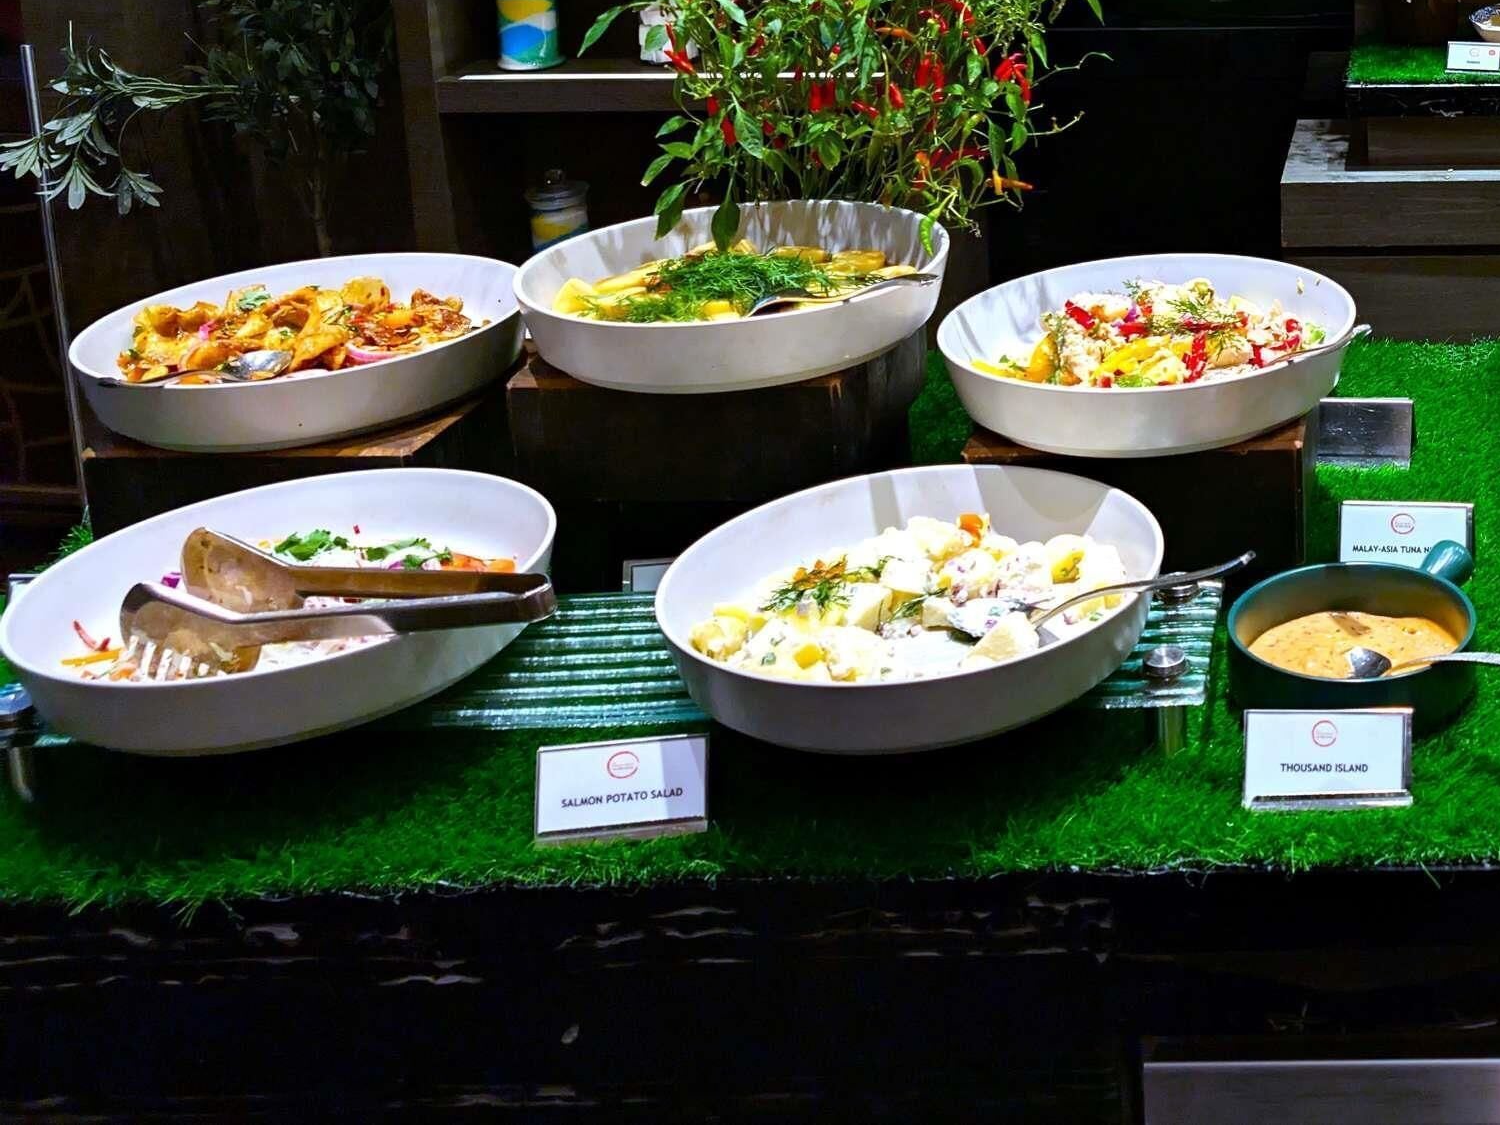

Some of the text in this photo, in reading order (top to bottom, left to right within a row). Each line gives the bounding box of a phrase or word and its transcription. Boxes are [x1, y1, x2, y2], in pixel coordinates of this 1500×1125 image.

[1352, 544, 1398, 554] MALAY-ASIA
[1401, 545, 1422, 554] TUNA
[1281, 763, 1369, 773] THOUSAND ISLAND
[561, 787, 684, 809] SALMON POTATO SALAD
